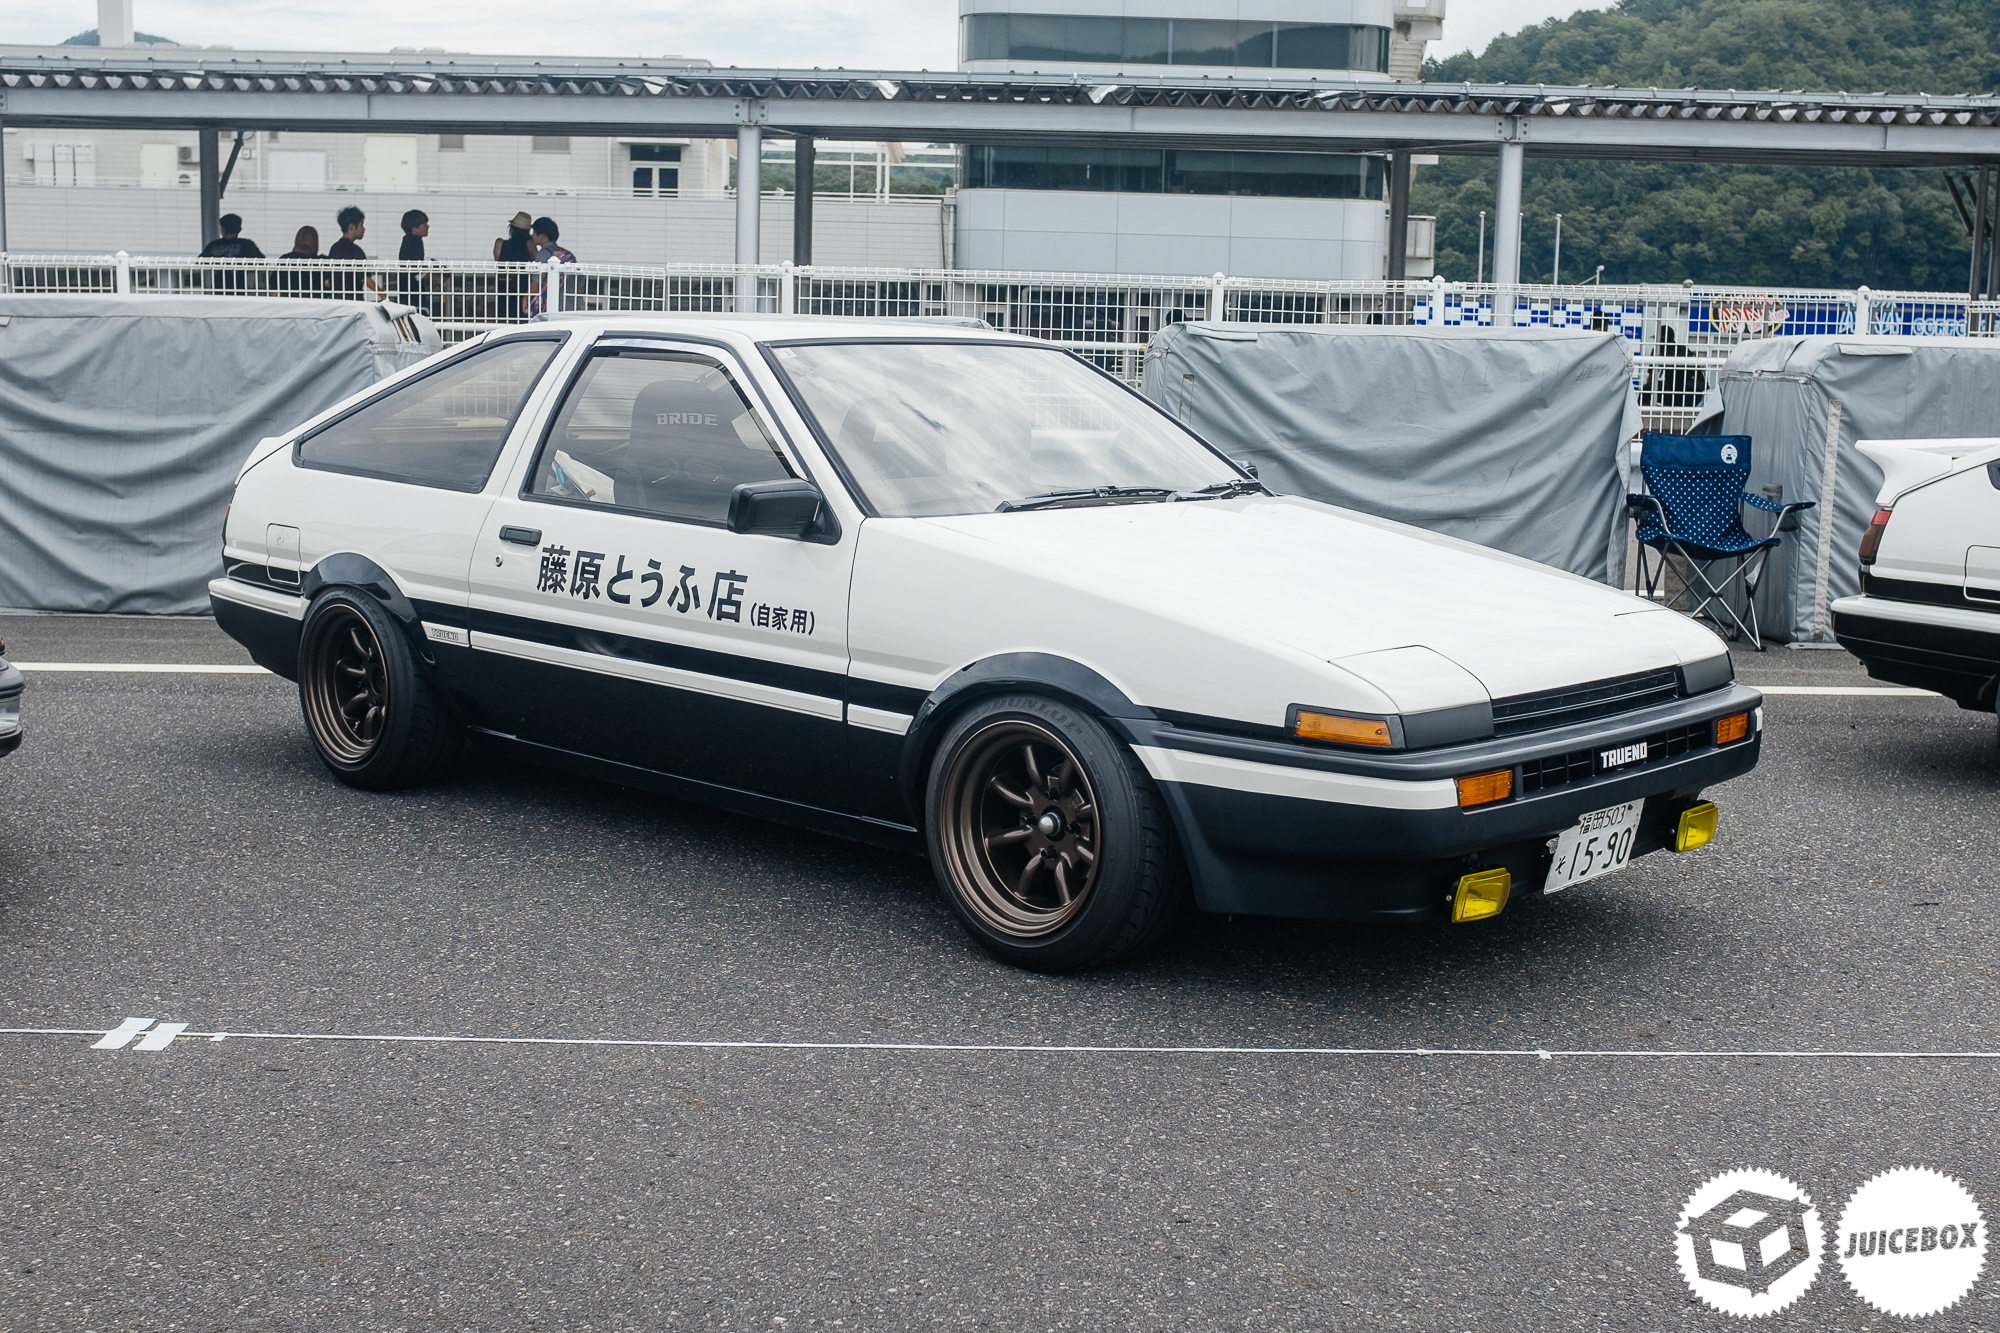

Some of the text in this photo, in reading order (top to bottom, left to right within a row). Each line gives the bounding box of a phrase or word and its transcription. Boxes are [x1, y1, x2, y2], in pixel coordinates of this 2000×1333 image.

[656, 412, 718, 426] BRIDE
[536, 544, 815, 636] 藤原とうふ店 (自家用)
[992, 696, 1083, 735] DUNLOP
[1600, 742, 1648, 769] TRUENO
[1568, 827, 1632, 881] 15-90
